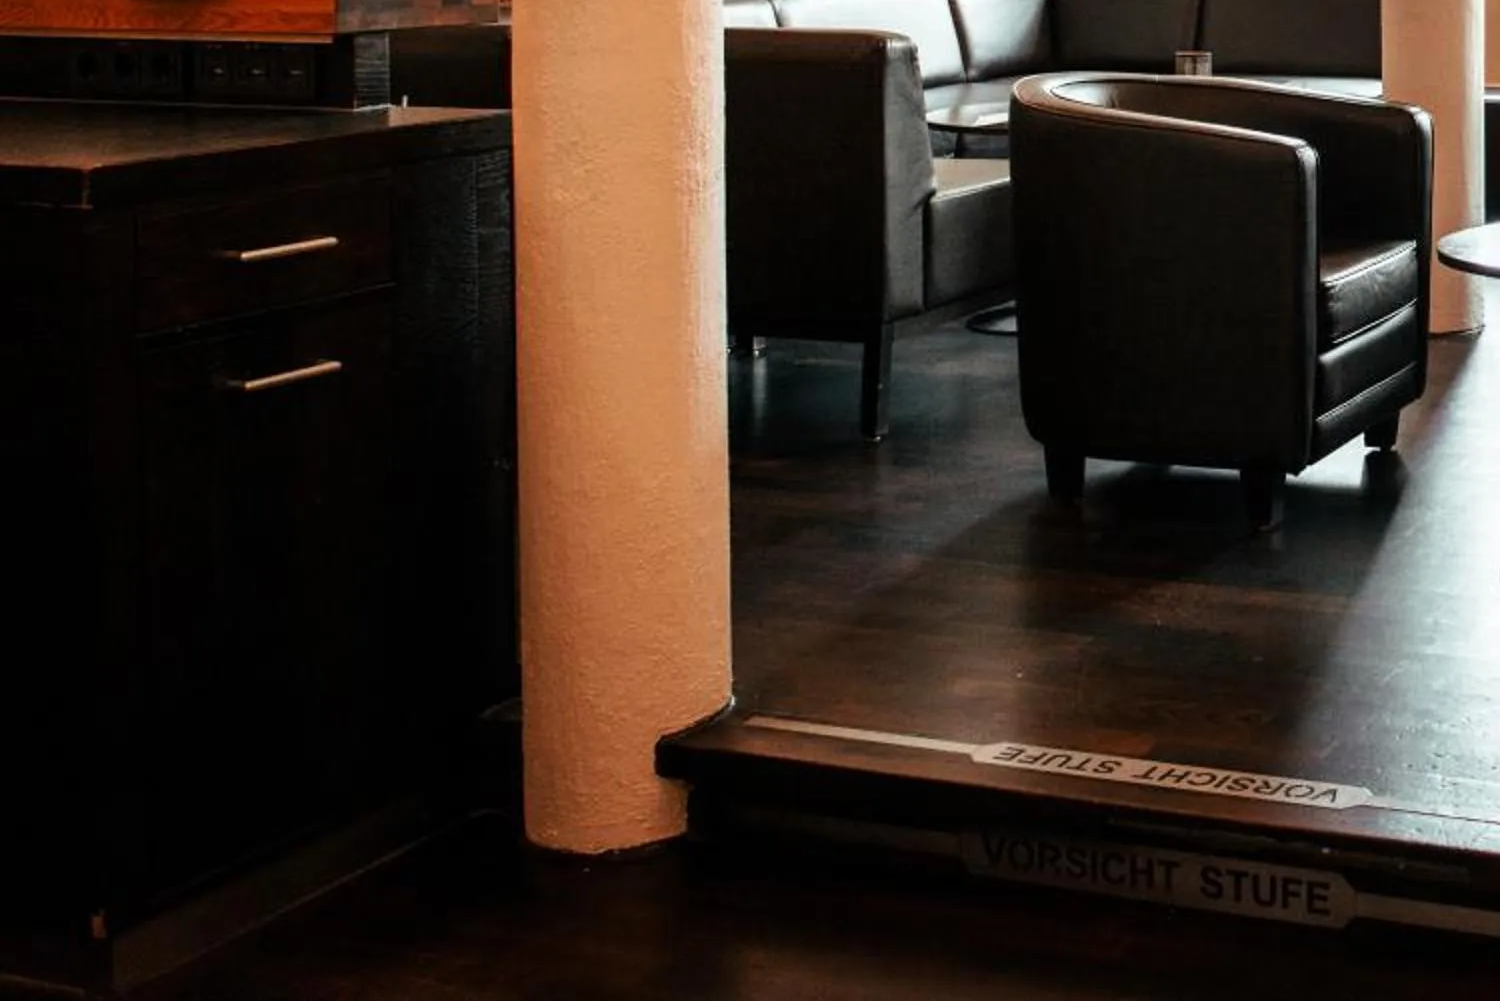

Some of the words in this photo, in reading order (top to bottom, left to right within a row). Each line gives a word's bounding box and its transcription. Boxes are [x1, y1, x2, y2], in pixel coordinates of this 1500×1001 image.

[995, 746, 1122, 774] STUFE
[1132, 764, 1338, 803] VORSICHT
[983, 836, 1180, 892] VORSICHT
[1201, 868, 1331, 915] STUFE
